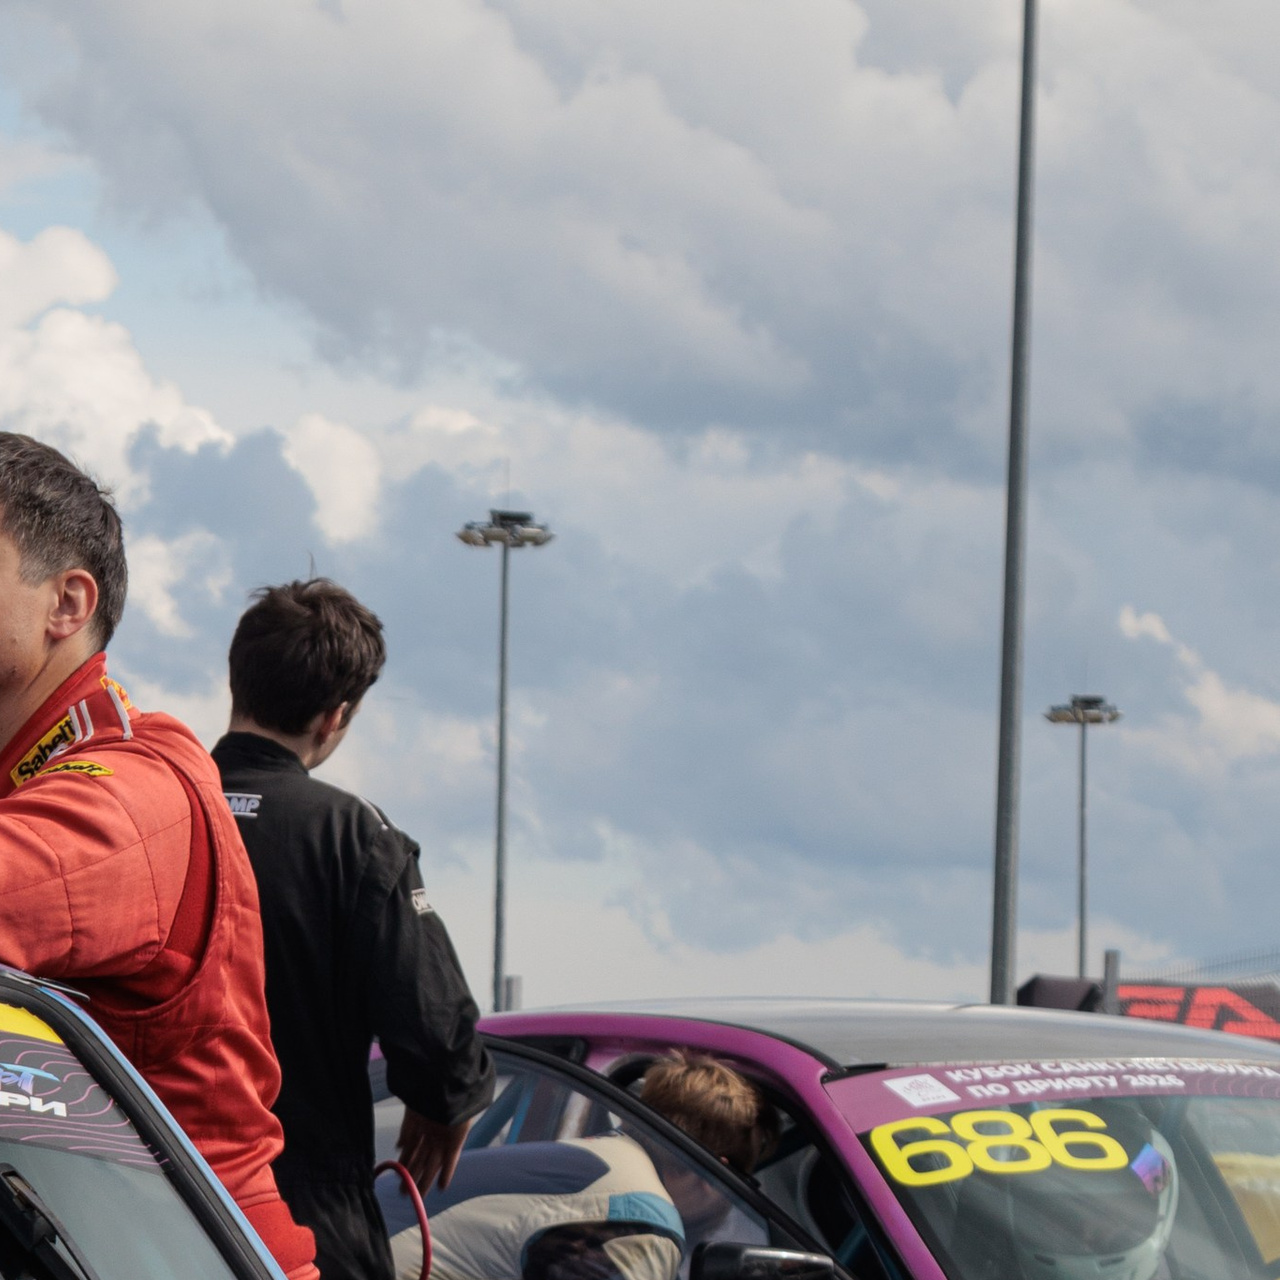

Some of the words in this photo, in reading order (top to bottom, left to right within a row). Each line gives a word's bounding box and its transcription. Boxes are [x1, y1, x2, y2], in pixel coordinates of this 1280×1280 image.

[228, 797, 260, 812] MP
[945, 1063, 1041, 1083] КУБОК
[966, 1082, 1010, 1098] ПО
[1012, 1075, 1118, 1095] ДРИФТУ
[1122, 1074, 1186, 1087] 2026
[870, 1108, 1129, 1187] 686
